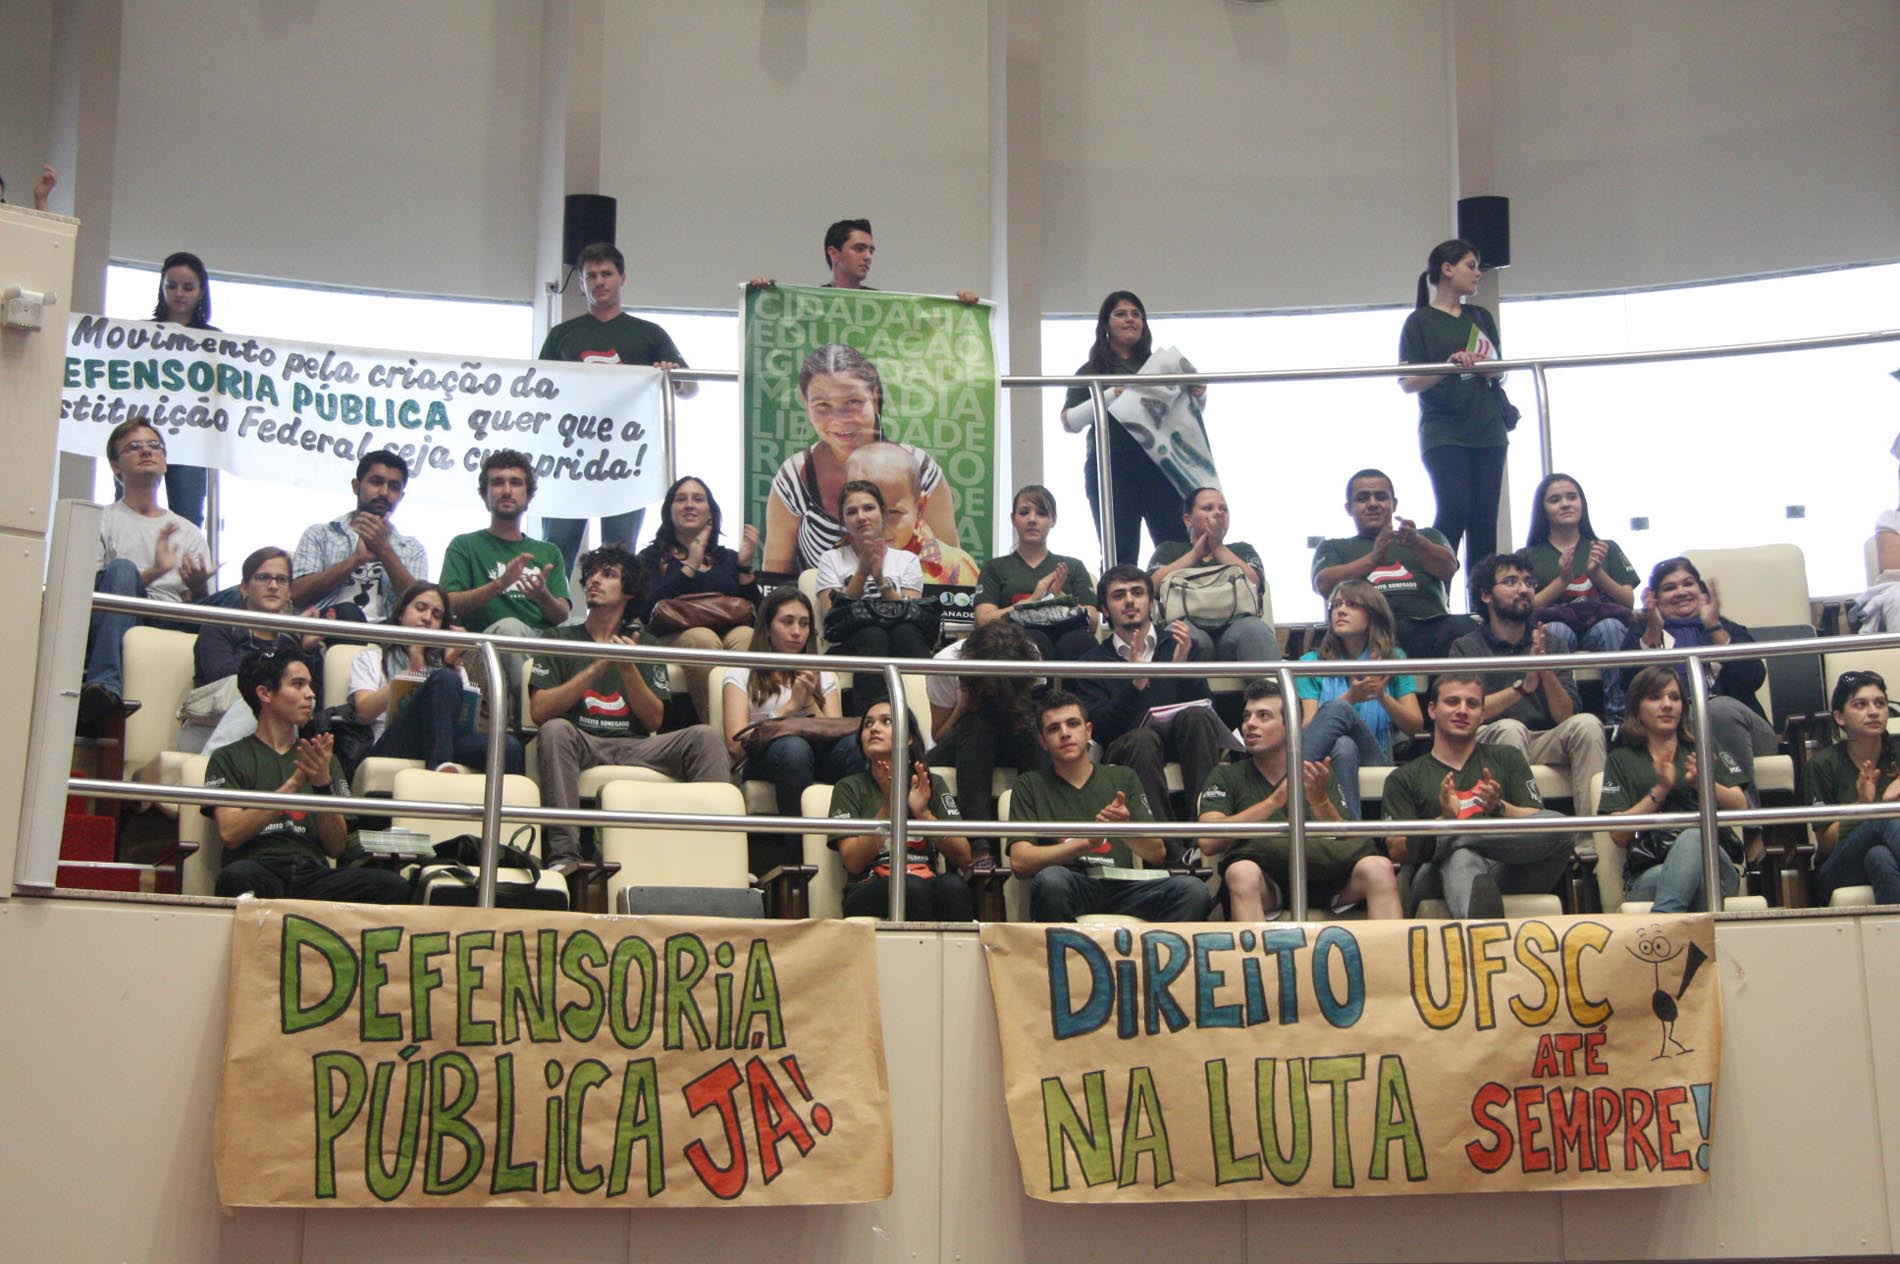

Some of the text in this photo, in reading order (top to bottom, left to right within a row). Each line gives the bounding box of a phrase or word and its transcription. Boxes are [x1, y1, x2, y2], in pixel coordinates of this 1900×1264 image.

[755, 292, 983, 335] CIDADANIA
[72, 316, 560, 401] Movimento pela criação da
[753, 347, 987, 388] IGDADE
[237, 406, 374, 461] Federal
[463, 443, 649, 481] cprida!
[293, 382, 452, 431] PÚBLICA
[467, 409, 552, 441] quer
[558, 413, 614, 448] que
[621, 420, 646, 442] a
[1408, 921, 1615, 1032] UFSC
[1532, 1025, 1609, 1079] ATÉ
[1041, 1053, 1428, 1192] NA LUTA
[1465, 1081, 1713, 1174] SEMPRE!
